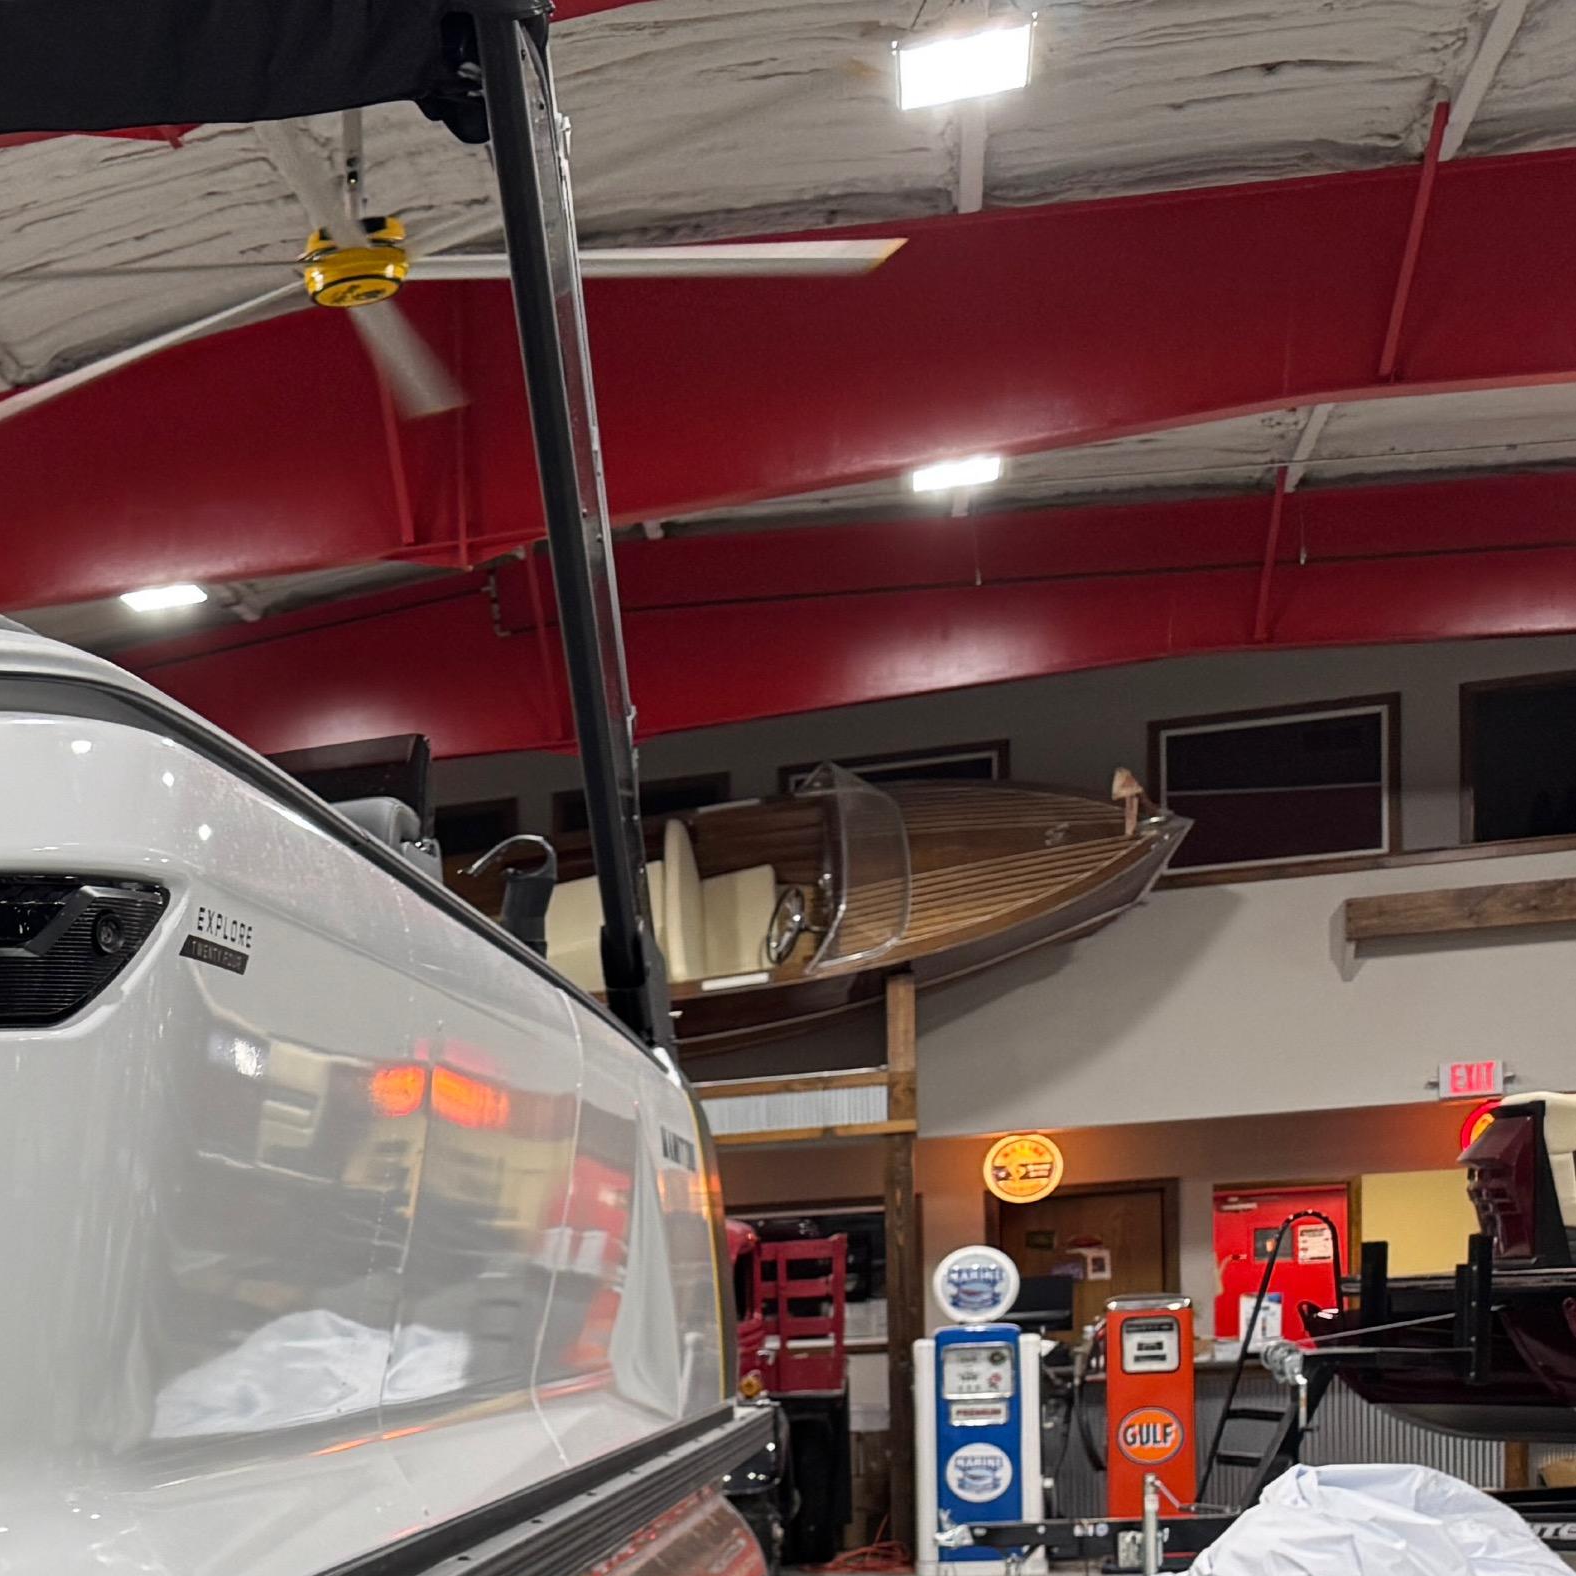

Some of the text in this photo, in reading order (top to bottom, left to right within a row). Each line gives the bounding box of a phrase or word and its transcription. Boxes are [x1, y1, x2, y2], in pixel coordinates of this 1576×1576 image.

[197, 906, 253, 948] EXPLORE
[1450, 1061, 1495, 1093] EXIT
[1123, 1422, 1174, 1447] GULF
